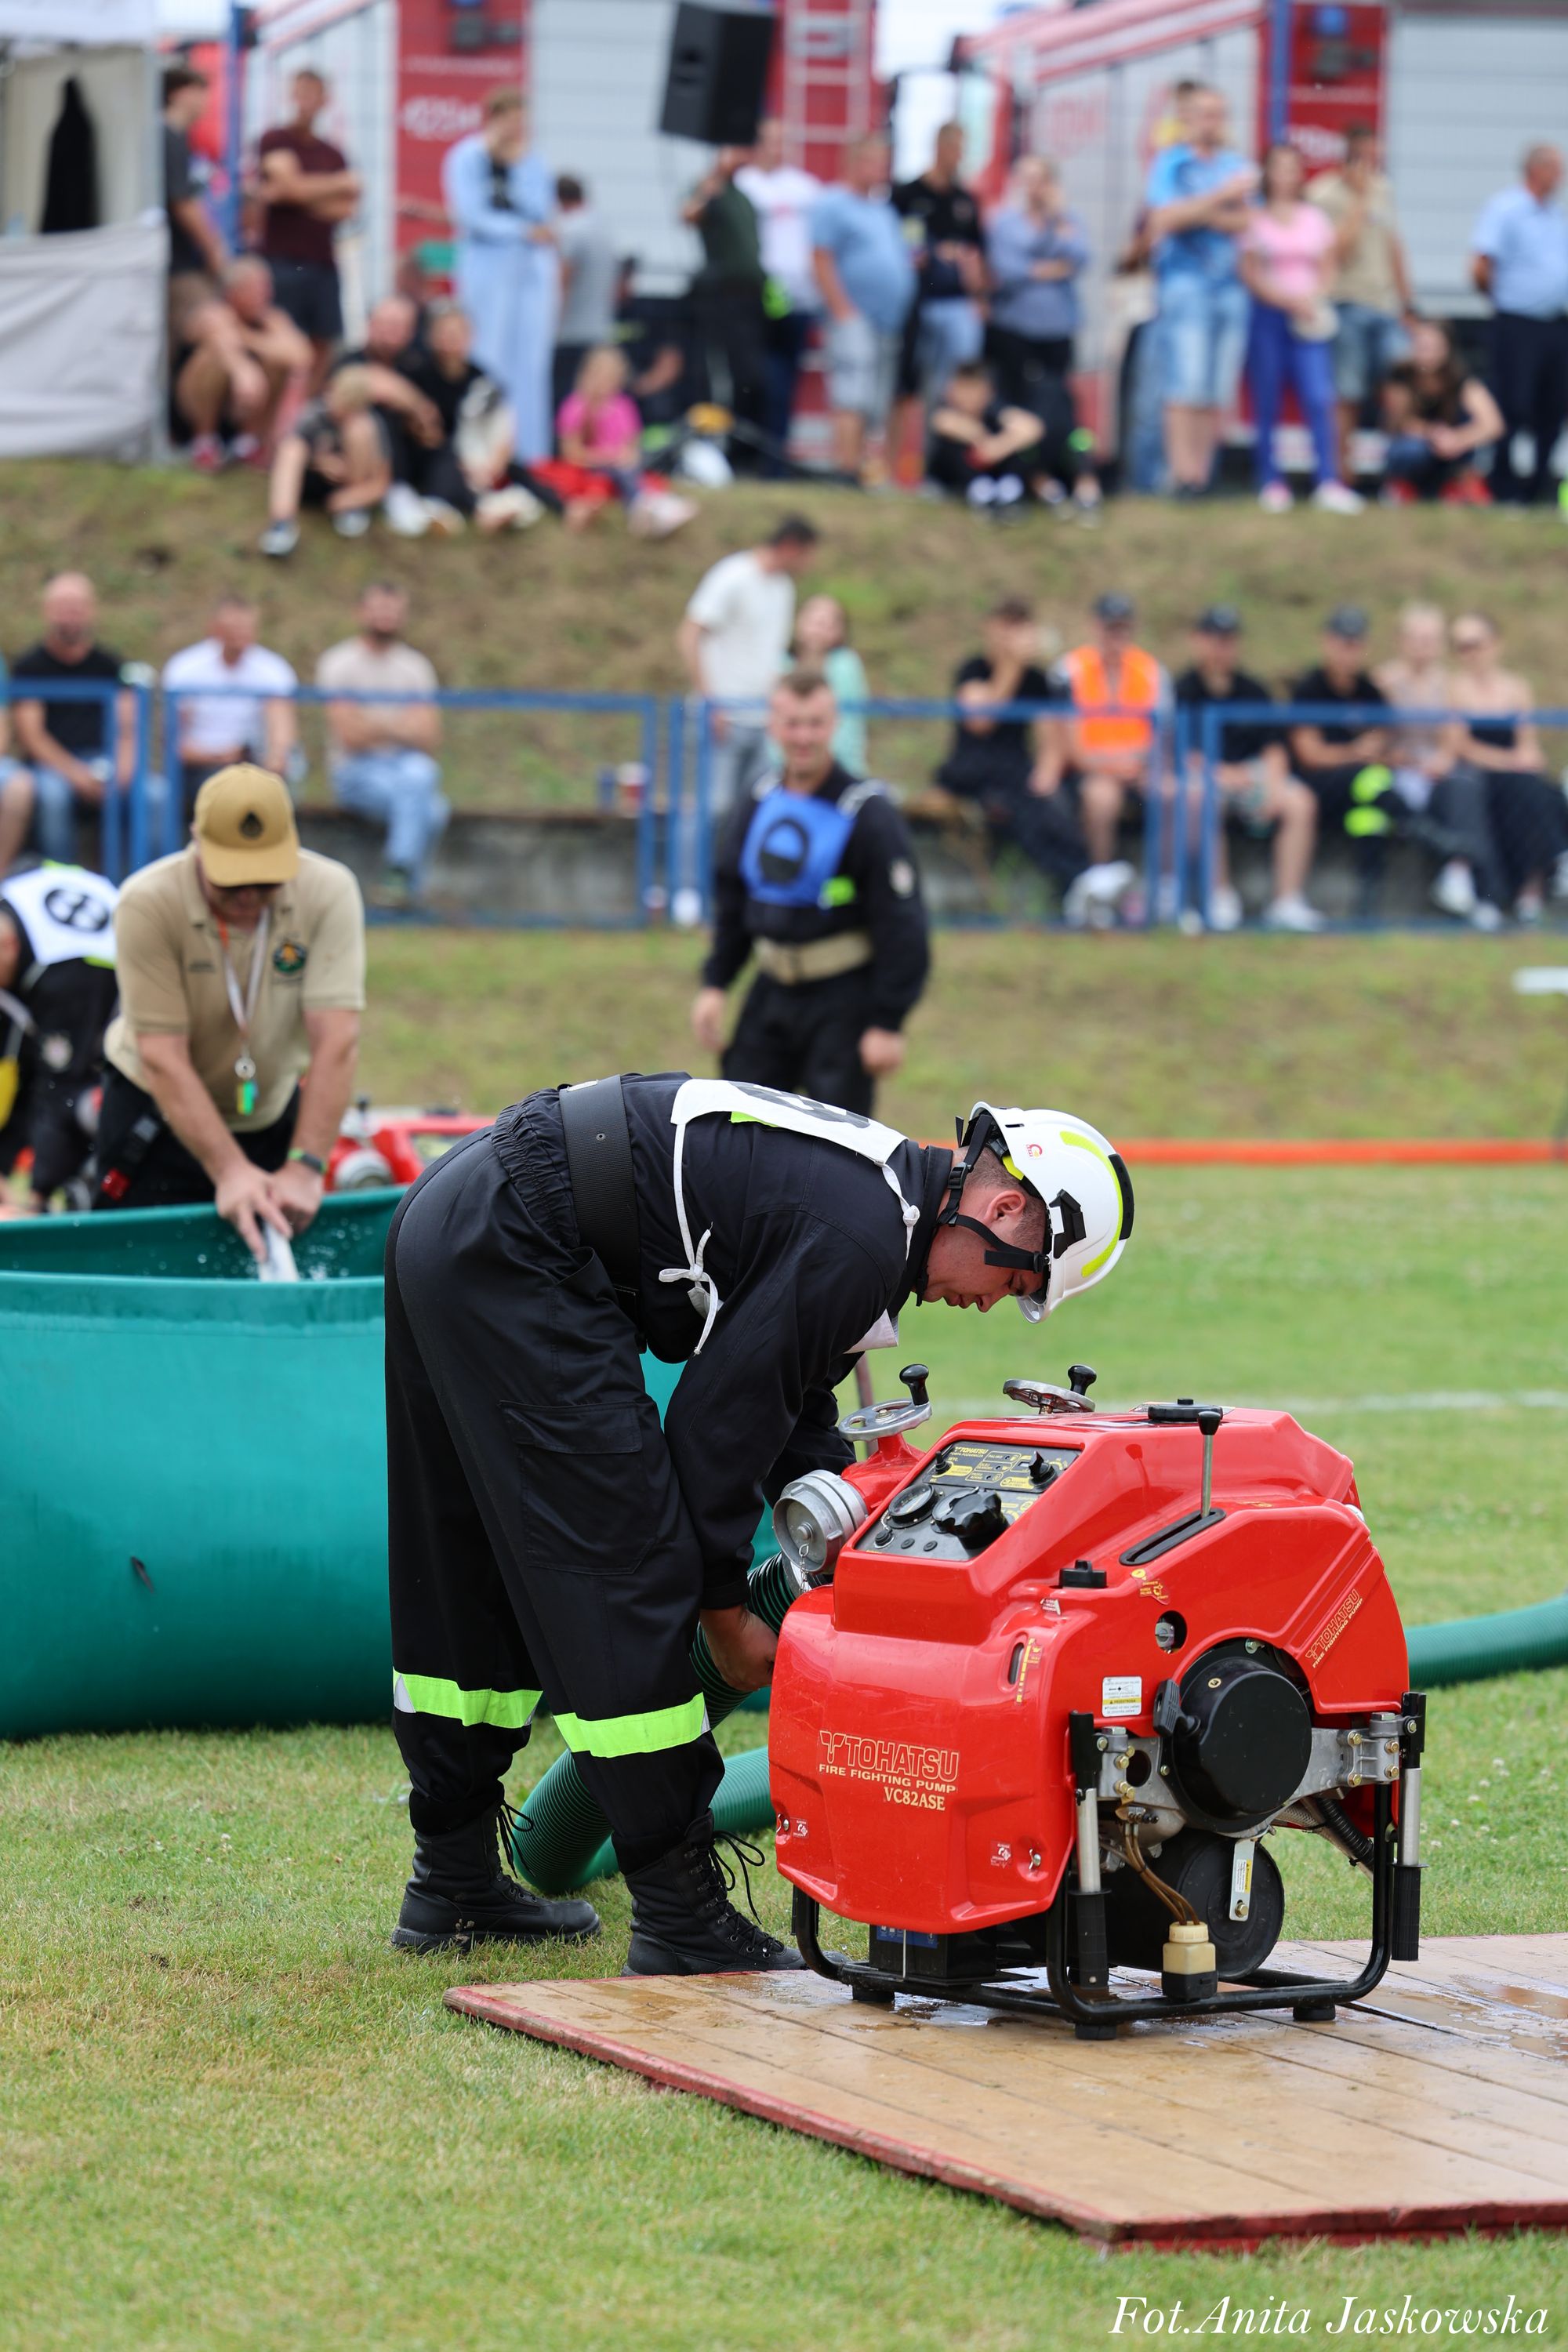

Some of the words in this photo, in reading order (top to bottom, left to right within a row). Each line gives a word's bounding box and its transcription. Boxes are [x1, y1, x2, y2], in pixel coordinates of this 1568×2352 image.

[1312, 1651, 1325, 1668] FIRE
[1324, 1619, 1348, 1652] FIGHTING
[1348, 1598, 1363, 1619] PUMP
[1317, 1588, 1360, 1650] TOHATSU
[818, 1763, 847, 1777] FIRE
[850, 1769, 912, 1788] FIGHTING
[916, 1780, 956, 1794] PUMP
[844, 1735, 960, 1783] TOHATSU
[884, 1786, 946, 1811] VC82ASE
